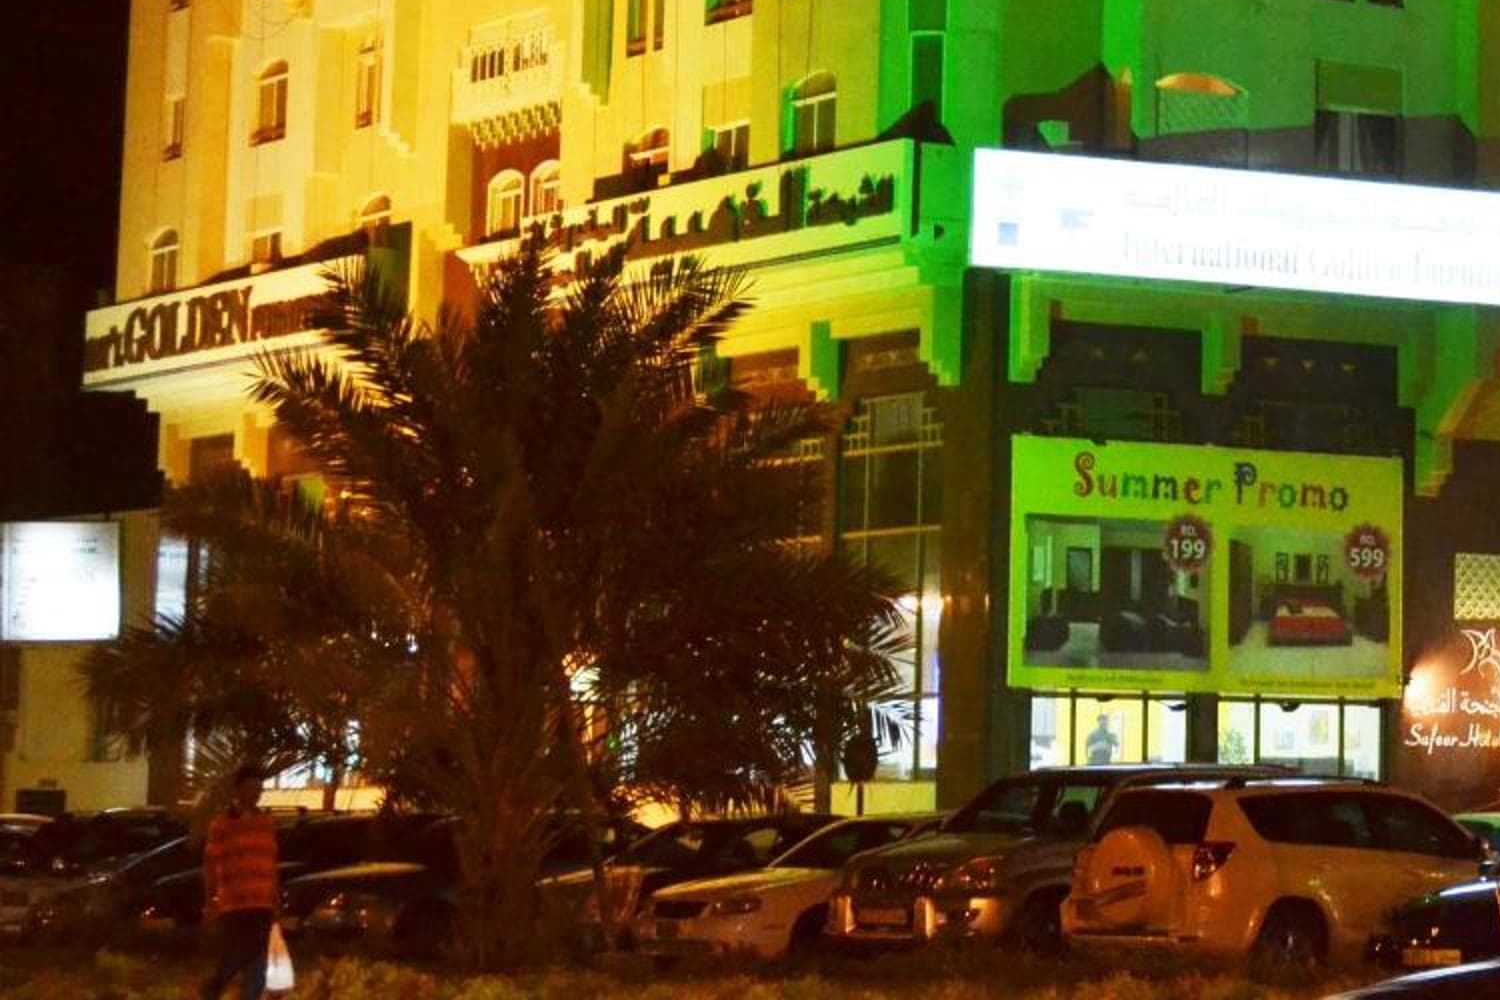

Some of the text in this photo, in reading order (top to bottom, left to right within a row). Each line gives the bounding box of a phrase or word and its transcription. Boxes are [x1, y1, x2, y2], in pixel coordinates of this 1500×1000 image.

[124, 286, 253, 364] GOLDEN
[1073, 451, 1349, 511] Summer Promo
[1170, 538, 1206, 559] 199
[1350, 549, 1385, 568] 599
